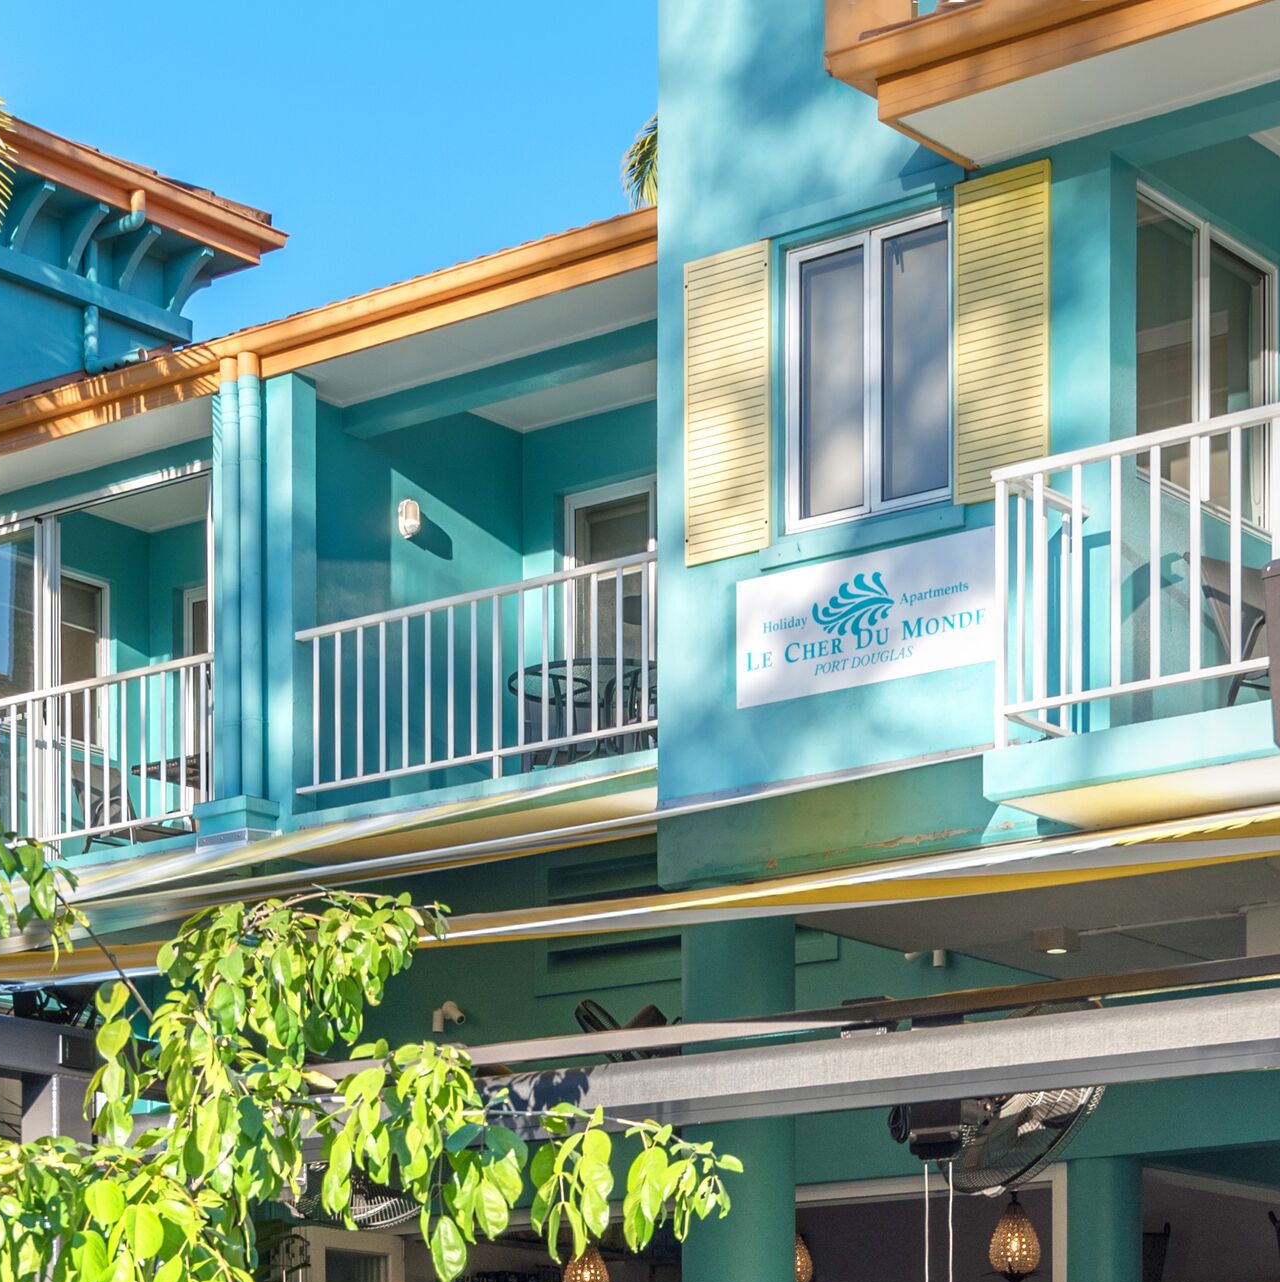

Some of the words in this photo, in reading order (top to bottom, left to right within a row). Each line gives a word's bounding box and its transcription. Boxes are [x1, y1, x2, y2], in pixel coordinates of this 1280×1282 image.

[762, 615, 808, 634] Holiday
[900, 581, 969, 606] Apartments
[746, 651, 773, 672] LE
[784, 637, 843, 663] CHER
[856, 627, 889, 650] DU
[901, 607, 986, 641] MONDE
[814, 658, 849, 677] PORT
[851, 645, 914, 669] DOUGLAS
